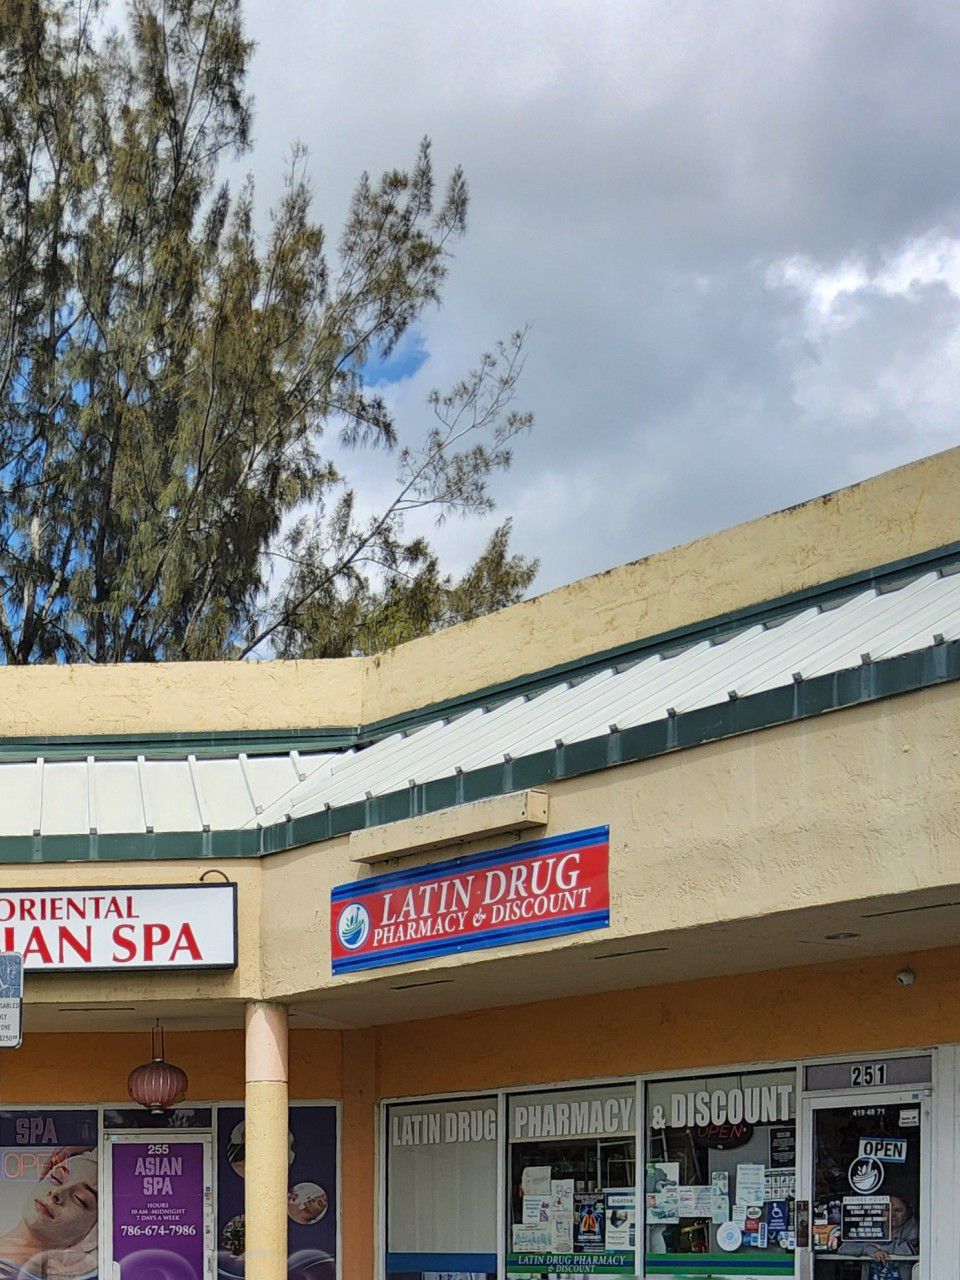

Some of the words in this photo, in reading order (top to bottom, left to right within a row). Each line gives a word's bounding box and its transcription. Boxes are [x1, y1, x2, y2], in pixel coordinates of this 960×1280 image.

[380, 875, 474, 926] LATIN
[482, 853, 581, 905] DRUG
[372, 910, 468, 947] PHARMACY
[471, 908, 487, 928] &
[490, 887, 592, 924] DISCOUNT
[111, 922, 203, 963] SPA
[851, 1064, 887, 1086] 251
[392, 1113, 441, 1146] LATIN
[445, 1108, 496, 1143] DRUG
[514, 1098, 633, 1139] PHARMACY
[651, 1104, 666, 1130] &
[671, 1085, 793, 1128] DISCOUNT
[15, 1117, 58, 1144] SPA
[147, 1144, 170, 1155] 255
[863, 1141, 904, 1158] OPEN
[134, 1157, 183, 1176] ASIAN
[143, 1177, 173, 1195] SPA
[120, 1225, 196, 1236] 786-674-7986
[518, 1255, 544, 1265] LATIN
[546, 1255, 572, 1265] DRUG
[573, 1255, 626, 1265] PHARMACY
[555, 1264, 596, 1273] DISCOUNT
